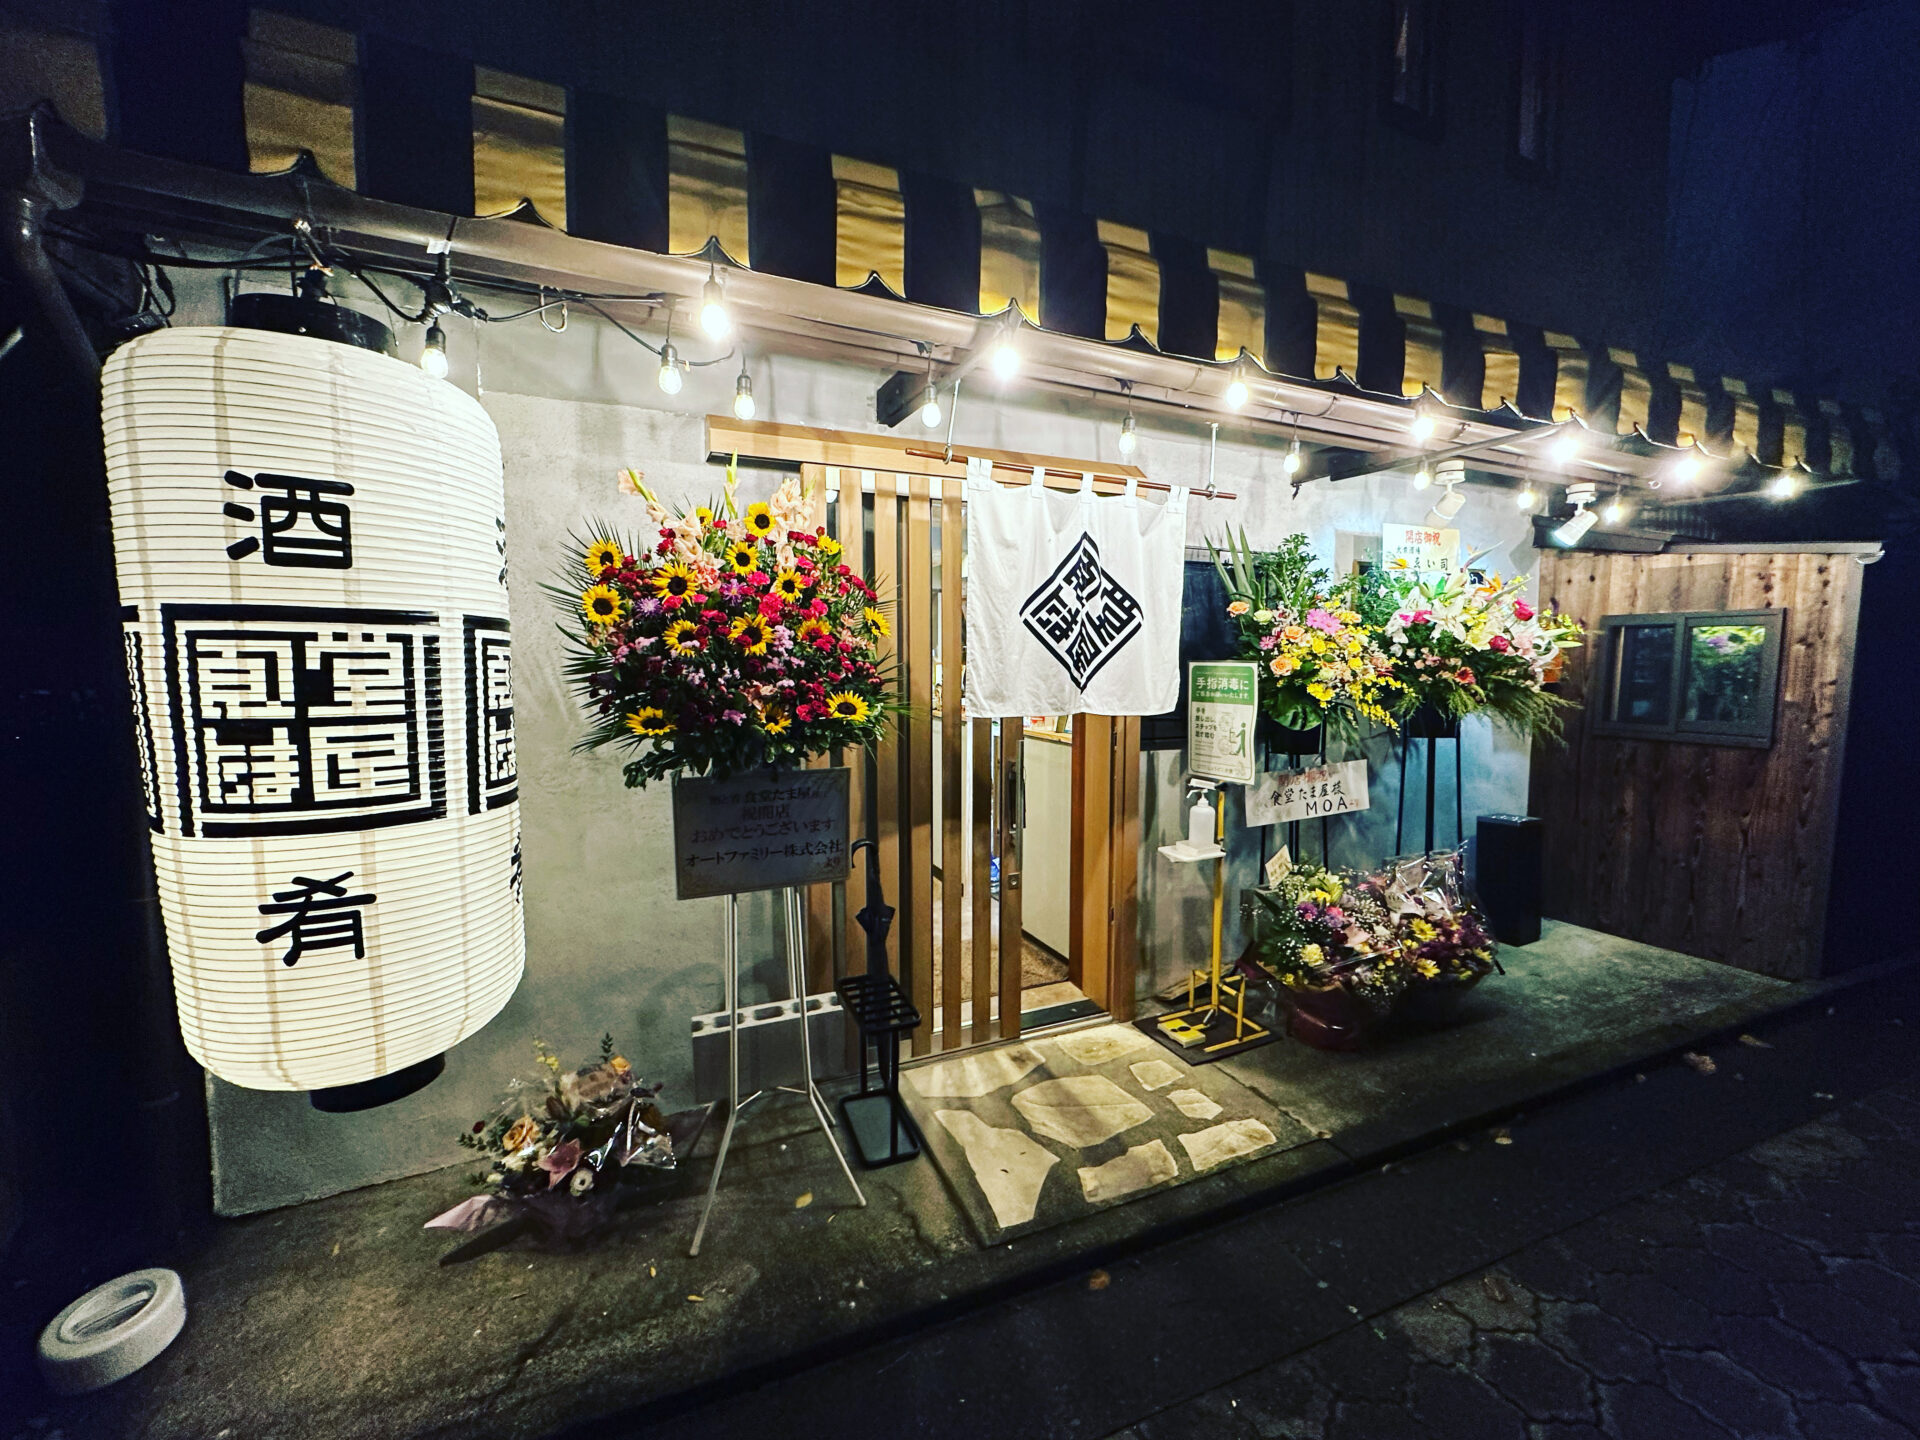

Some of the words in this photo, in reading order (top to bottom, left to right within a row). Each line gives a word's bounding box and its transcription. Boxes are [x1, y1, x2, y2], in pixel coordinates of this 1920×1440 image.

[224, 470, 354, 569] 酒
[1196, 676, 1250, 690] 手指消毒に
[1305, 796, 1348, 816] MOA
[691, 818, 836, 844] おめでとうございます
[685, 839, 843, 868] オートファミリー株式会社
[255, 871, 377, 967] 肴
